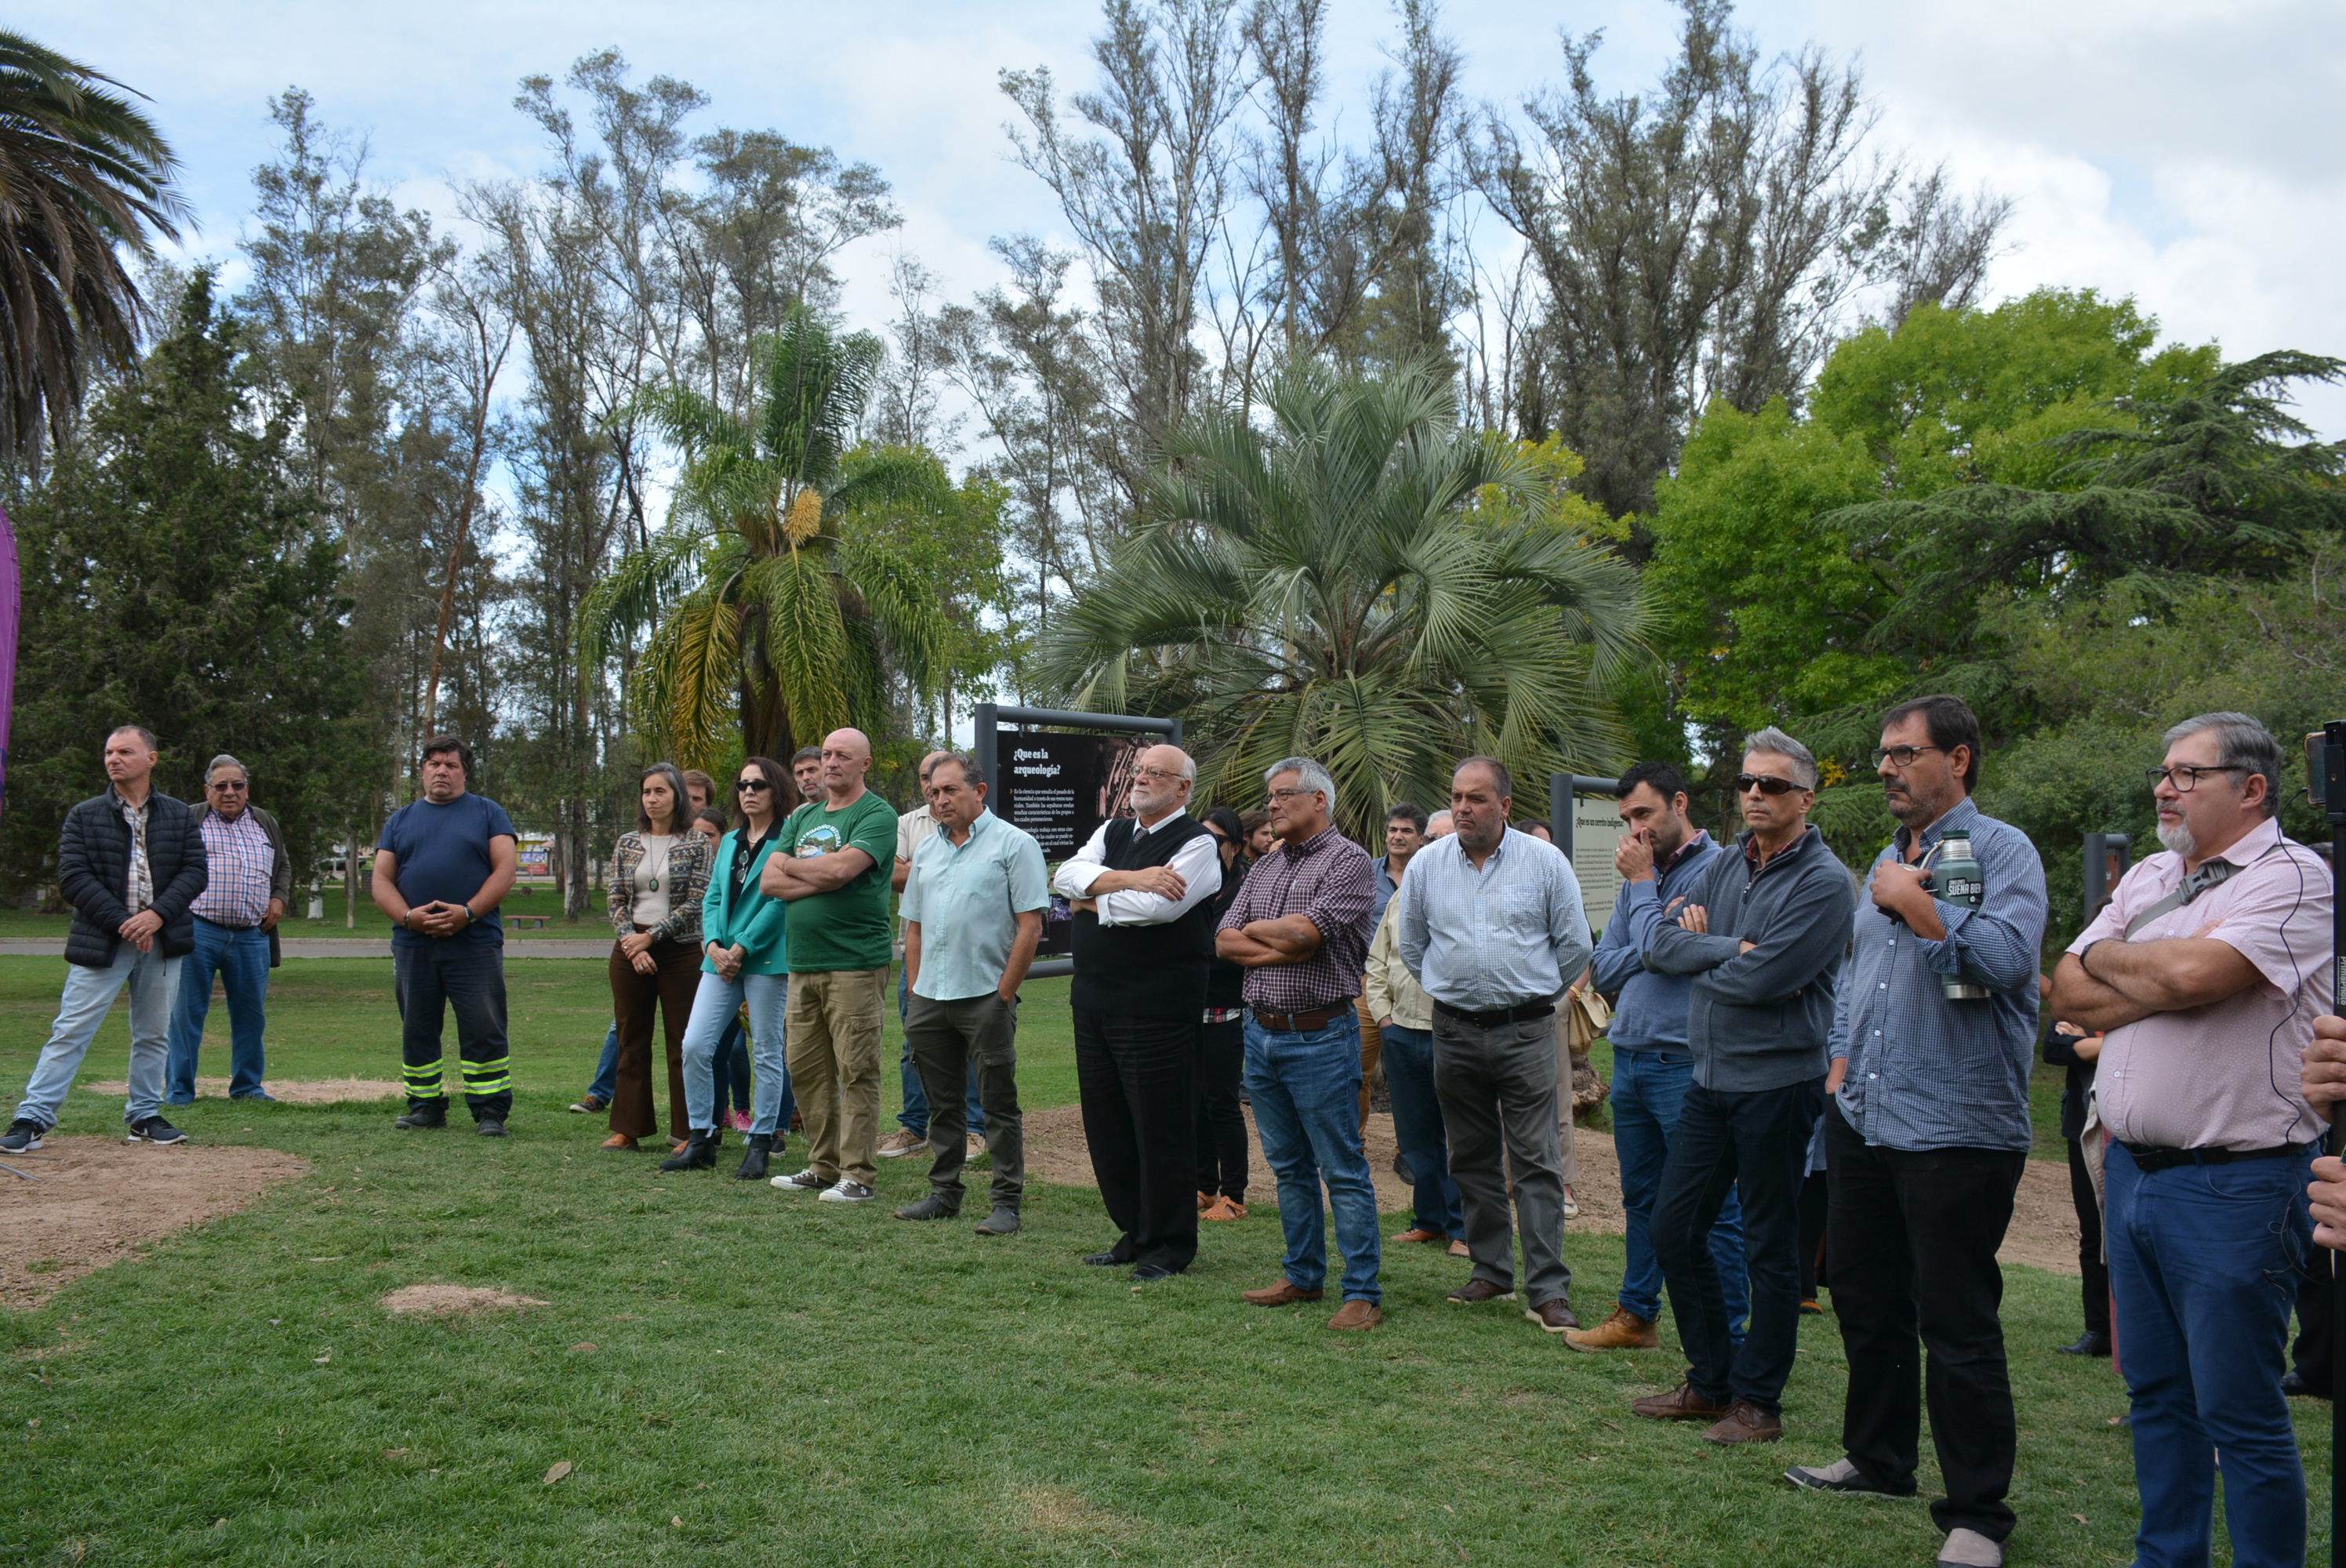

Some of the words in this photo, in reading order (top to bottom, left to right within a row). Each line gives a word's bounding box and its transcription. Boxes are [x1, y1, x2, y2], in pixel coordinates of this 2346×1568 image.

[1013, 748, 1032, 761] ¿Que
[1041, 748, 1049, 759] la
[1013, 764, 1061, 778] arqueología?
[797, 824, 831, 846] PATRIMONIO
[830, 826, 842, 848] NATURAL
[1948, 884, 1969, 895] SUENA
